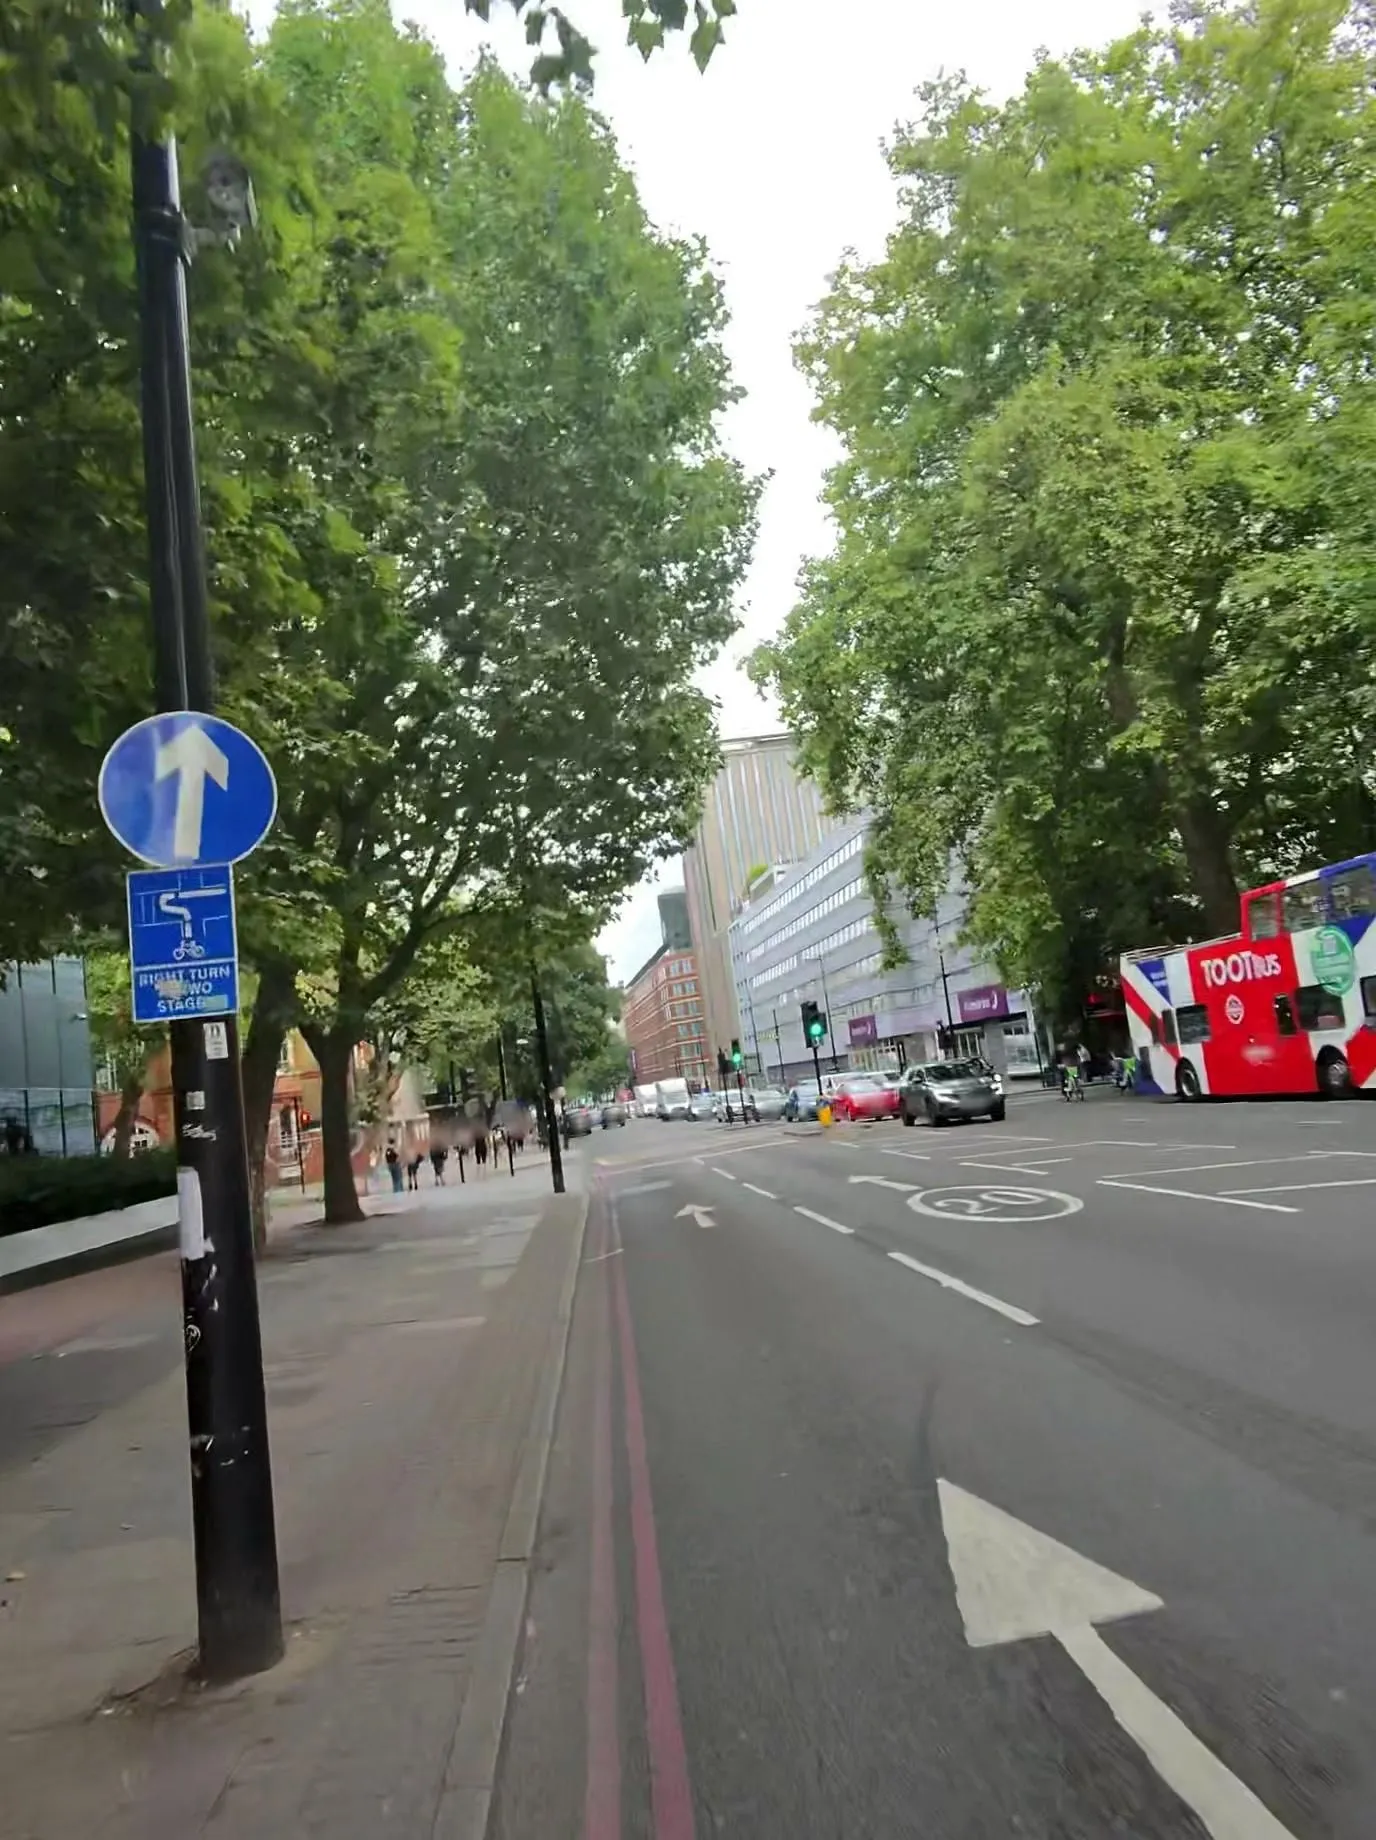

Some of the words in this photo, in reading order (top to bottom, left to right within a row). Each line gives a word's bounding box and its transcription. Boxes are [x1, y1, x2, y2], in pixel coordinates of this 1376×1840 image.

[139, 969, 185, 987] RIGHT
[188, 965, 230, 980] TURN
[183, 981, 213, 995] WO
[934, 1191, 1045, 1213] 20
